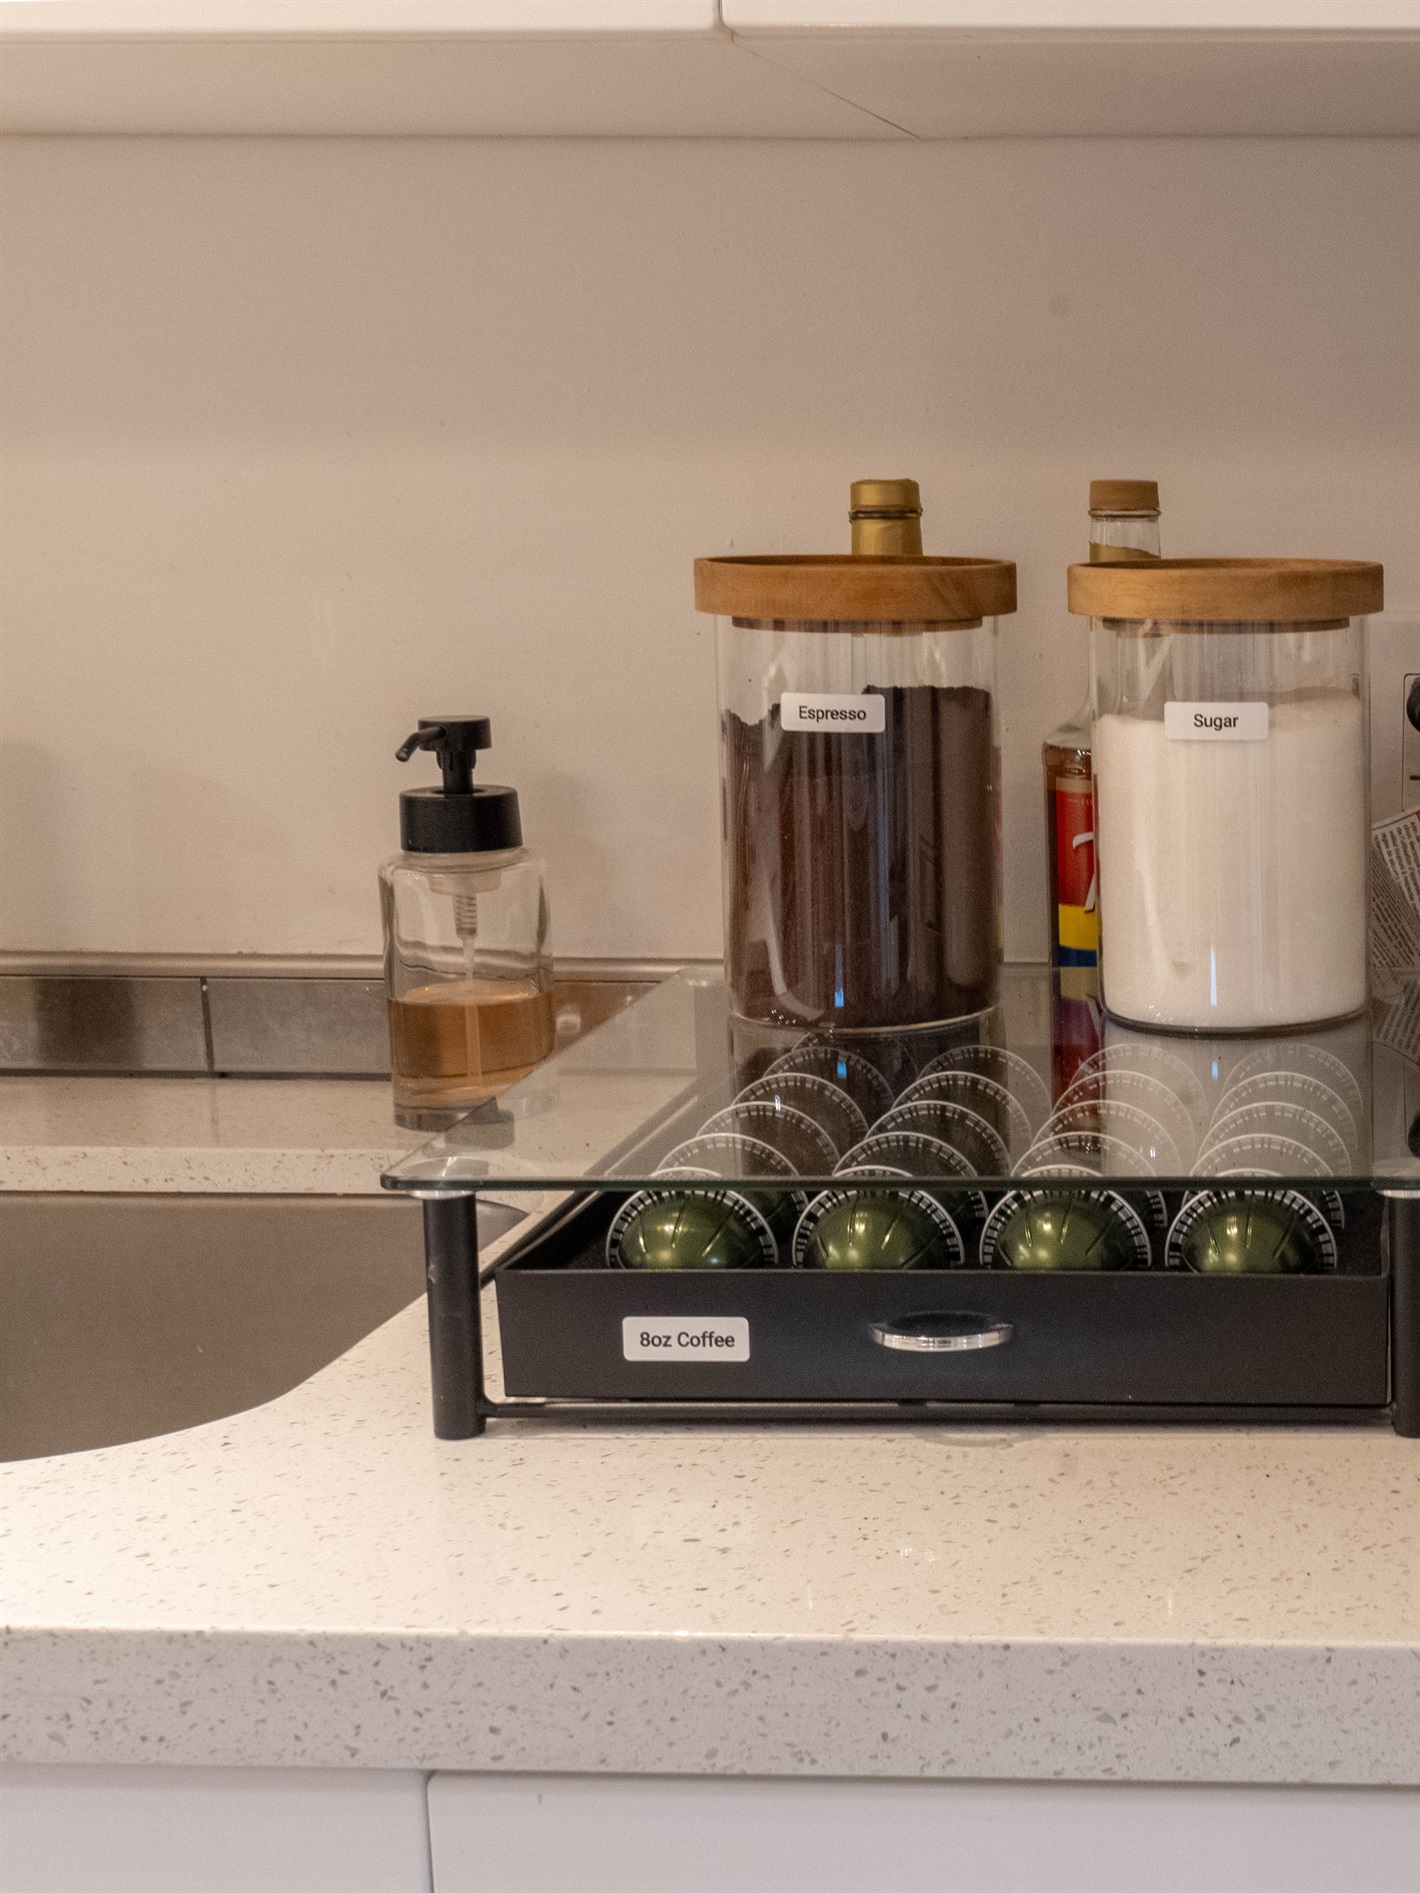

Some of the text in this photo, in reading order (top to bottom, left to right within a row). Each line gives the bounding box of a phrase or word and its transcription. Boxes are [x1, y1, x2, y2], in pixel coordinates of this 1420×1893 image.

[799, 706, 866, 722] Espresso
[1194, 714, 1238, 731] Sugar
[640, 1331, 735, 1347] 8oz Coffee
